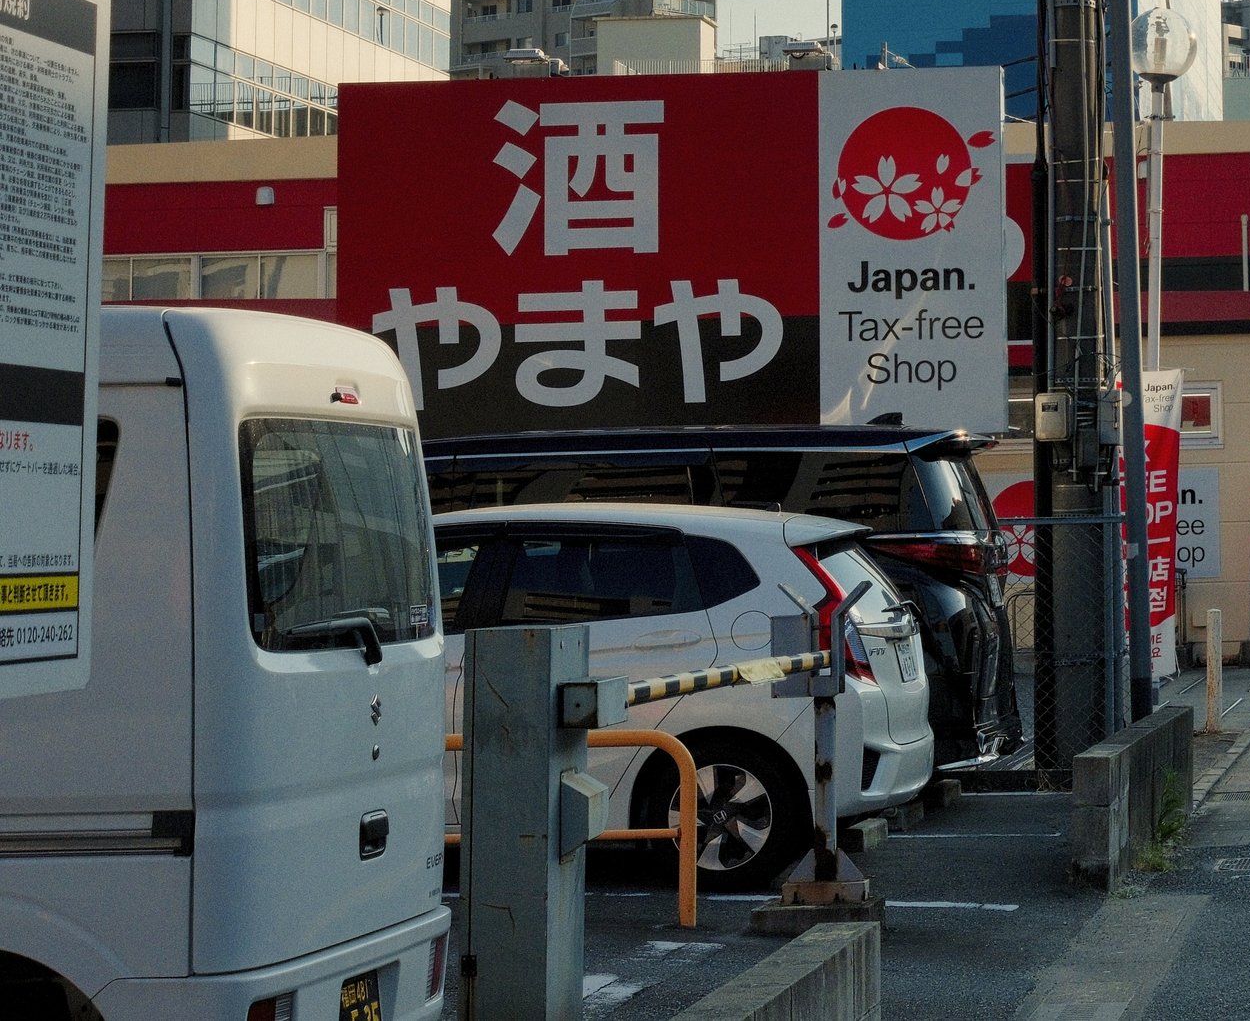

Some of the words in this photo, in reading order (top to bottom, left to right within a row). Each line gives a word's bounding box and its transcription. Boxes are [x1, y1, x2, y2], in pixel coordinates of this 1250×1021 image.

[492, 99, 665, 256] 酒
[847, 261, 977, 300] Japan.
[839, 309, 985, 342] Tax-free
[372, 279, 785, 412] やまや
[867, 353, 958, 392] Shop
[1153, 404, 1174, 413] Shop
